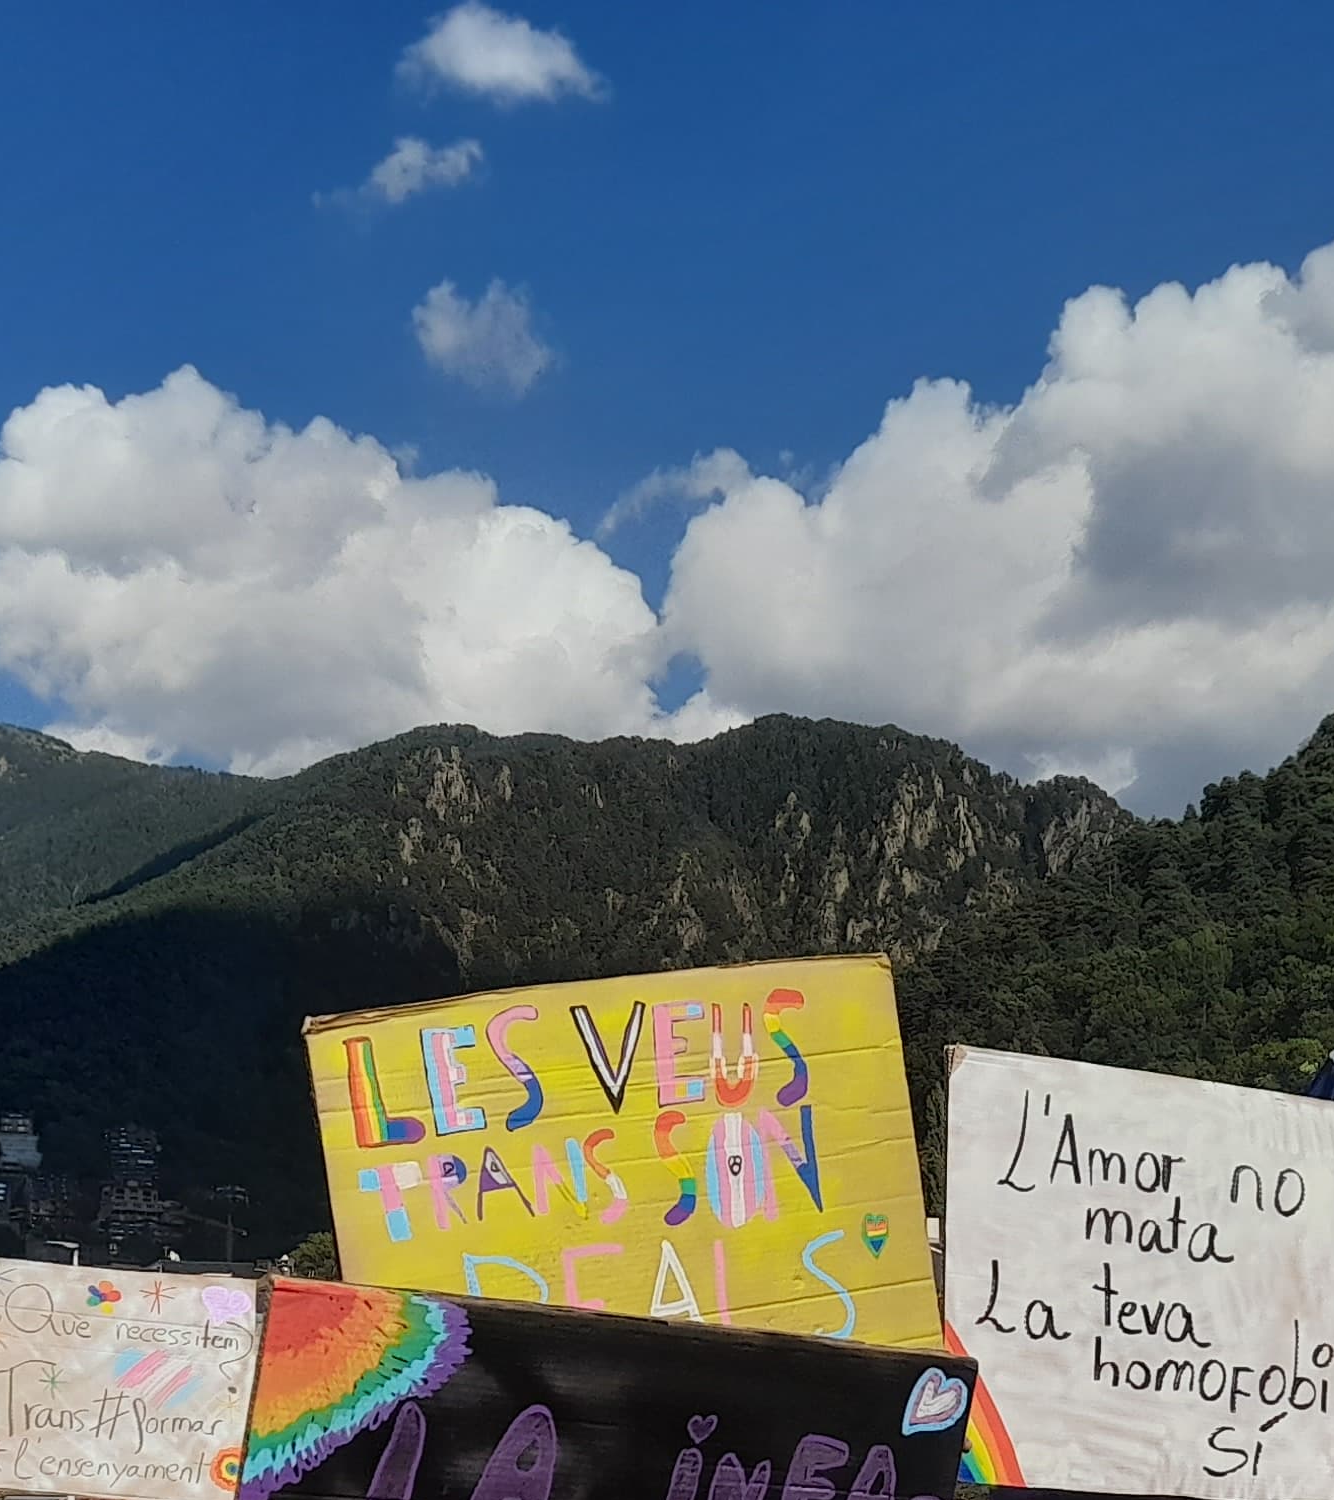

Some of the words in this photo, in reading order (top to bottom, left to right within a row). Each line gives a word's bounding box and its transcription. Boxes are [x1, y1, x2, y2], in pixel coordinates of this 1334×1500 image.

[342, 1004, 544, 1148] LES
[569, 987, 810, 1113] VEUS
[357, 1127, 630, 1242] TRANS
[997, 1089, 1185, 1194] L'Amor
[1230, 1163, 1306, 1217] no
[1085, 1197, 1235, 1264] mata
[4, 1283, 92, 1340] Què
[974, 1259, 1071, 1341] La
[1091, 1262, 1212, 1349] teva
